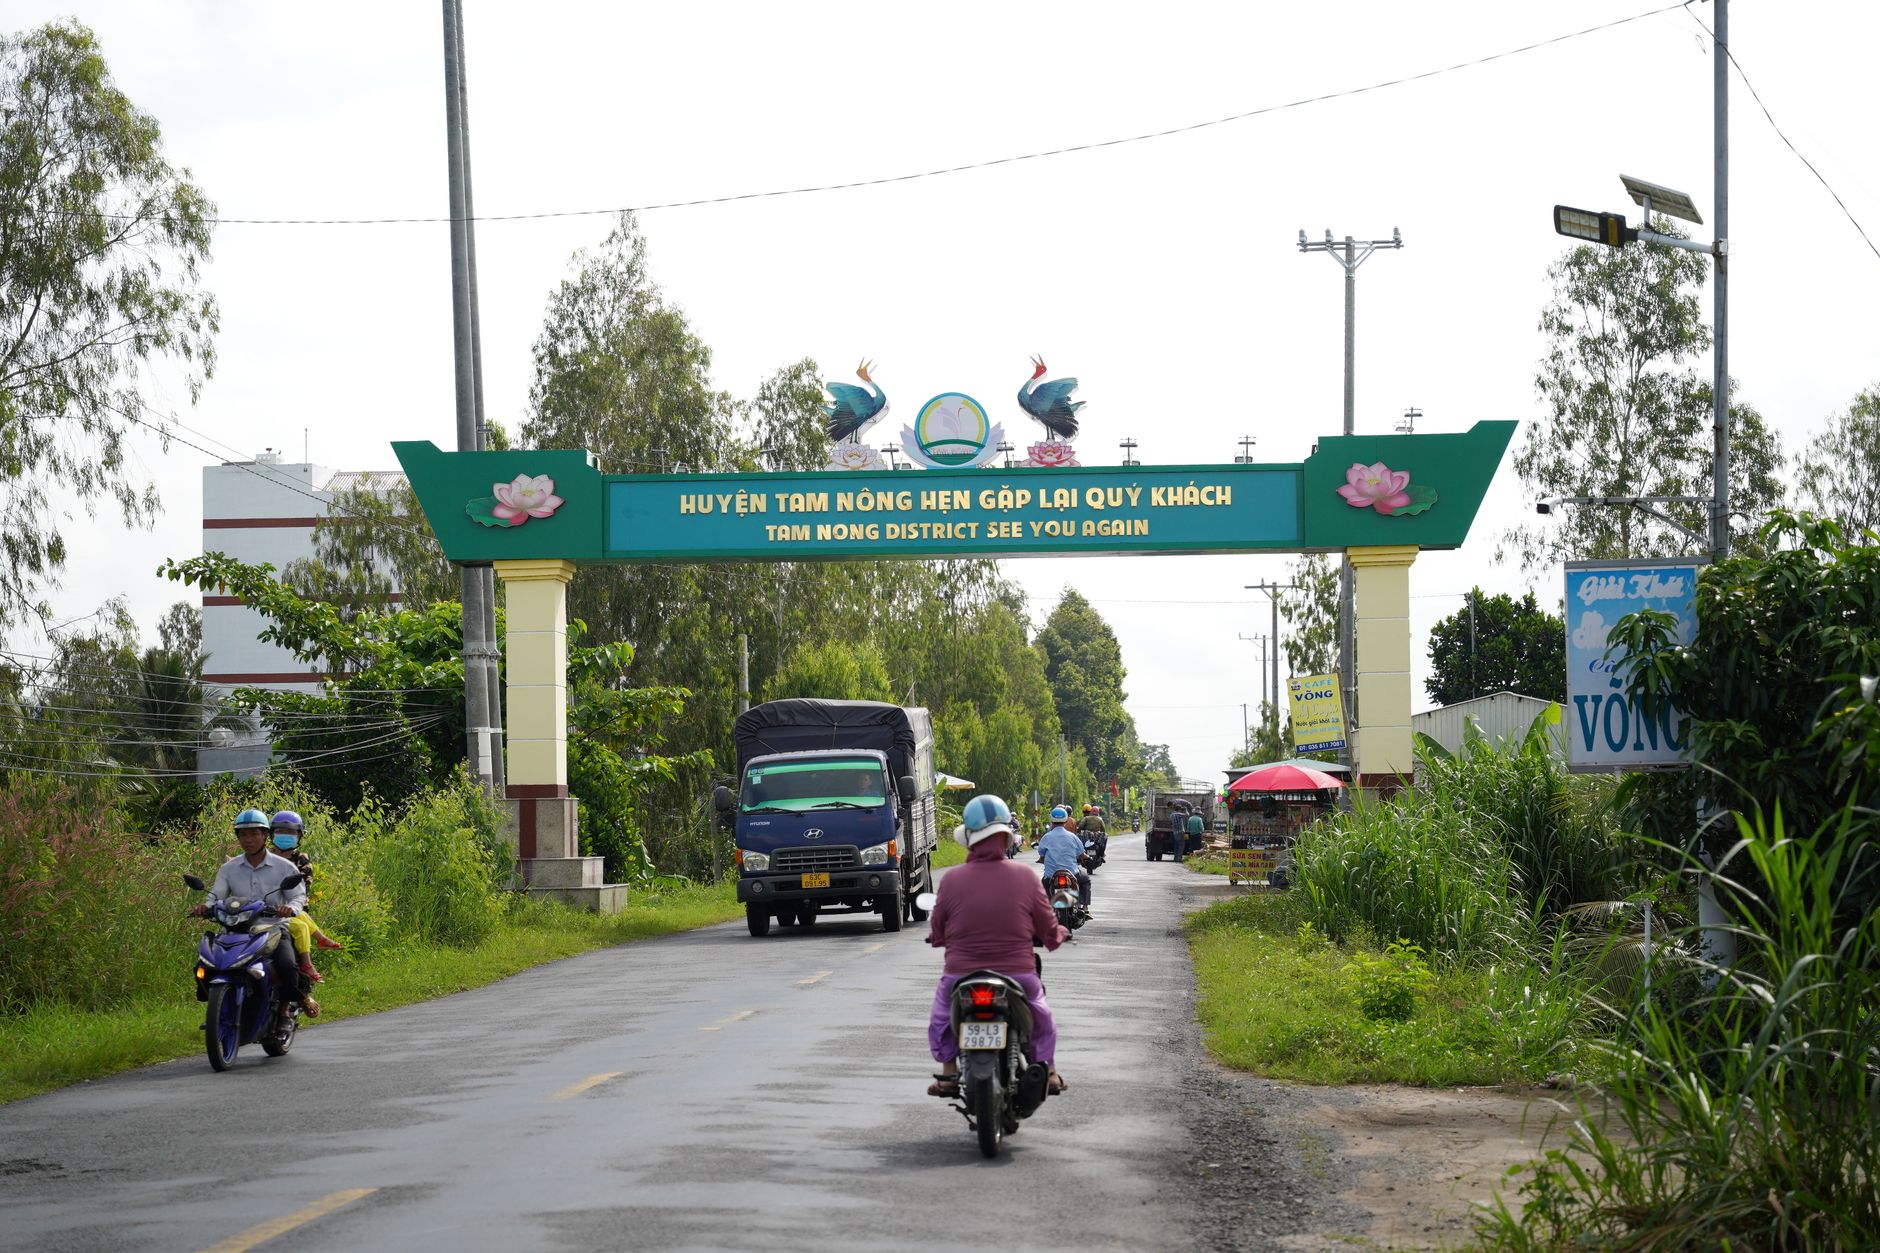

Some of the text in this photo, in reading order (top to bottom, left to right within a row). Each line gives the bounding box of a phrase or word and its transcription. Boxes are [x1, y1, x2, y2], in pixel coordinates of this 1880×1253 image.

[680, 480, 1233, 516] HUYỆN TAM NÔNG HẸN GẶP LẠI QUÝ KHÁCH
[765, 519, 1149, 542] TAM NONG DISTRICT SEE YOU AGAIN
[1295, 690, 1333, 702] VÕNG
[967, 1024, 999, 1036] 59-L3
